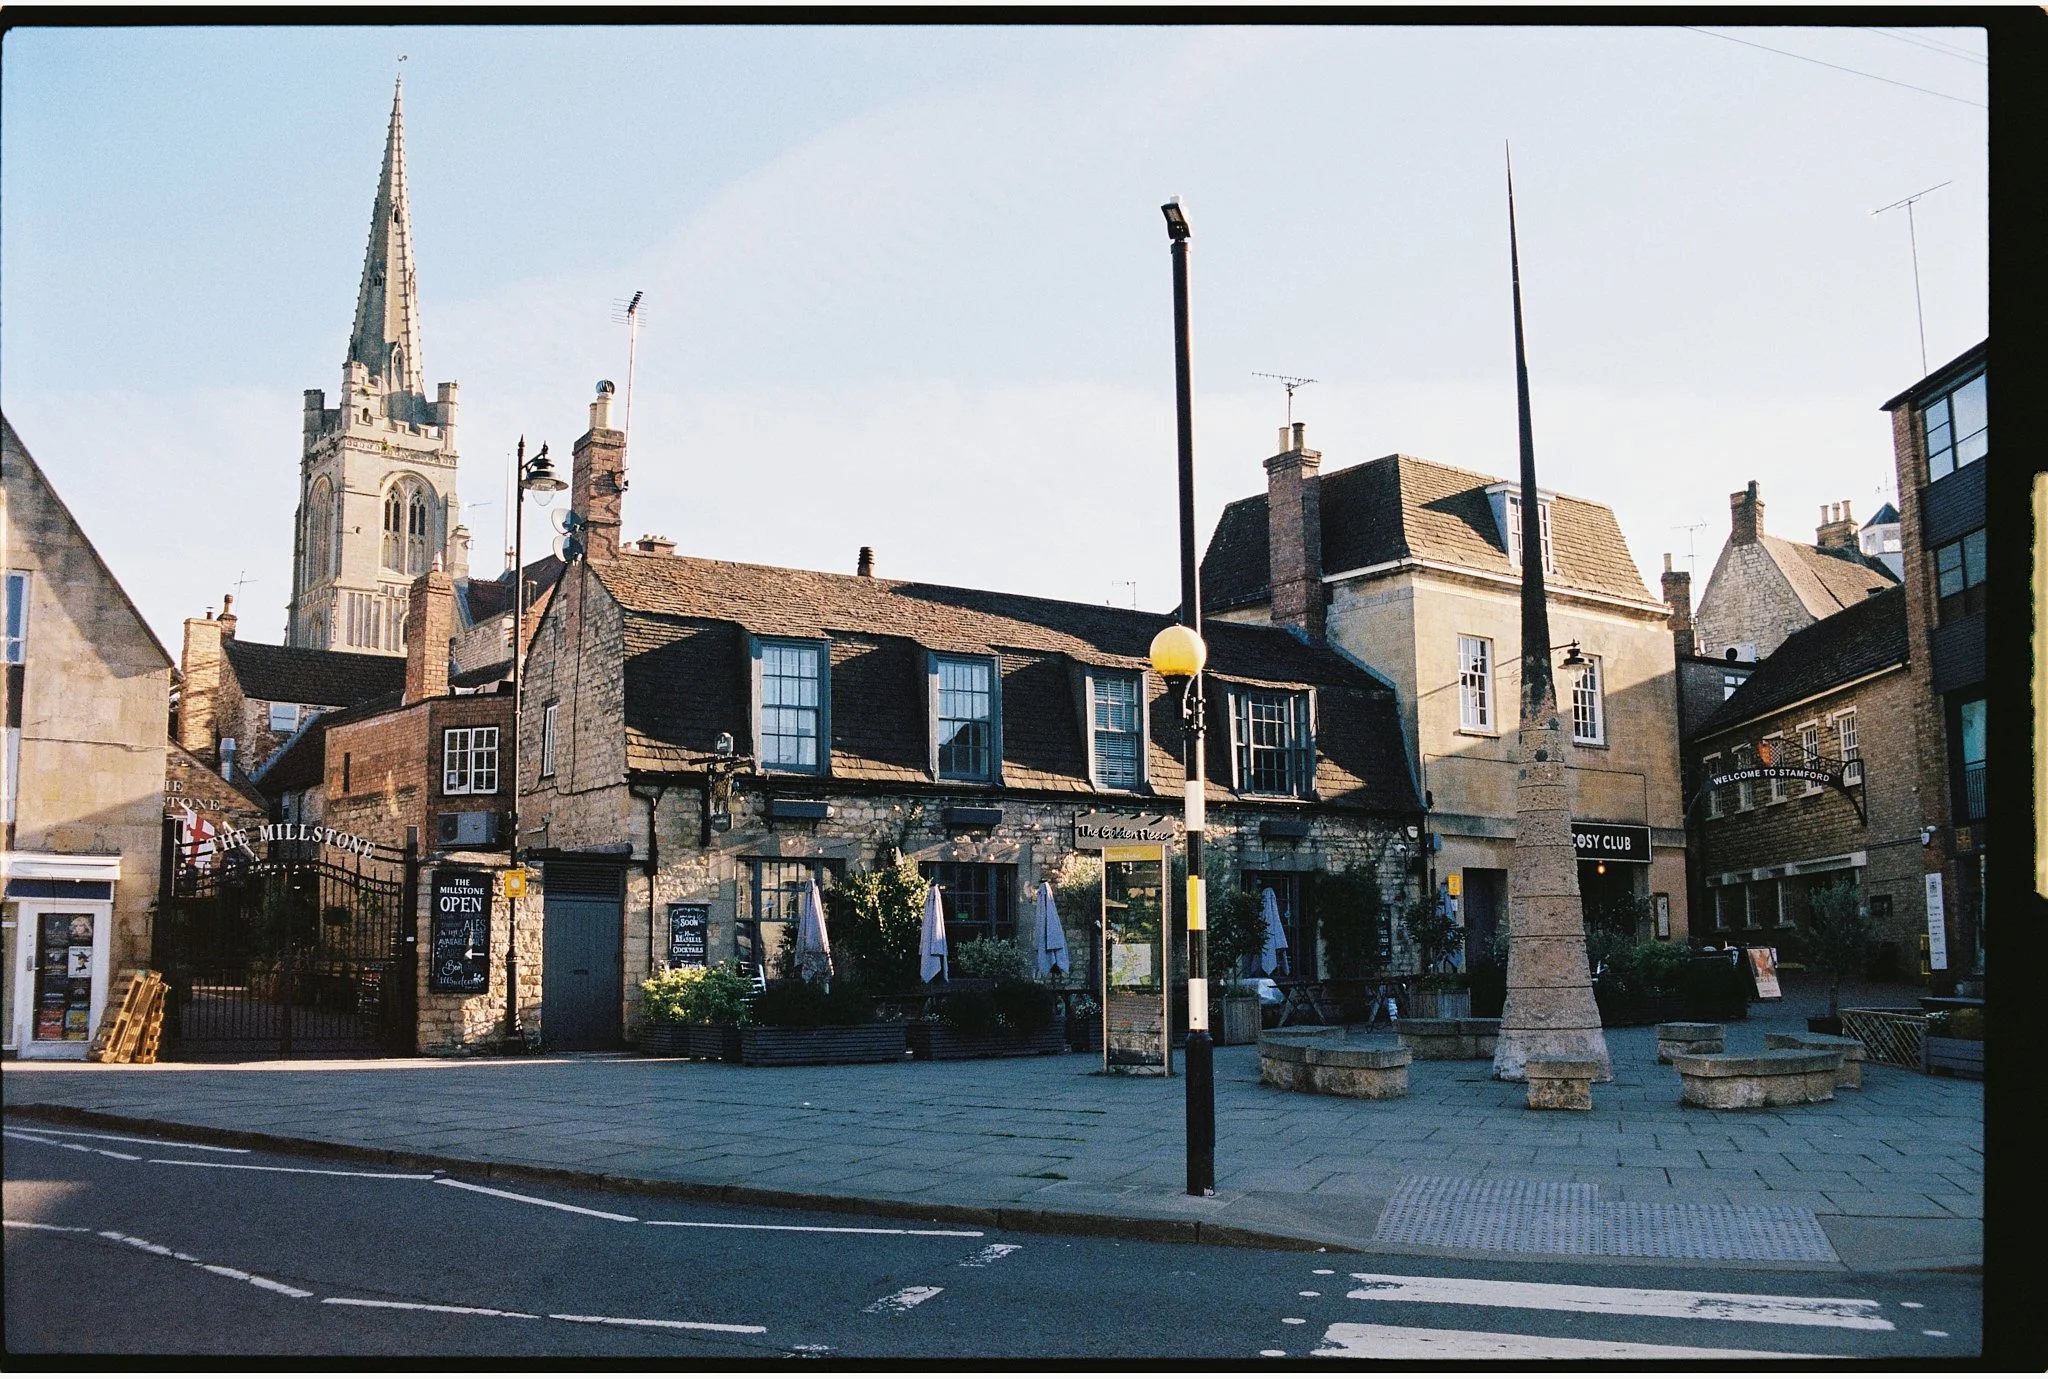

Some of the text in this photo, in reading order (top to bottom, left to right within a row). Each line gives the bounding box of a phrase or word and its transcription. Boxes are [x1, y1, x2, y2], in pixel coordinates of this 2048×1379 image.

[1713, 769, 1761, 785] WELCOME
[1779, 768, 1830, 782] STAMFORD
[1079, 823, 1099, 836] The
[1101, 825, 1138, 838] Golden
[206, 823, 376, 859] THE MILLSTONE
[1572, 833, 1632, 850] COSY CLUB
[454, 878, 471, 886] THE
[440, 886, 485, 895] MILLSTONE
[440, 896, 482, 913] OPEN
[463, 919, 486, 932] ALES
